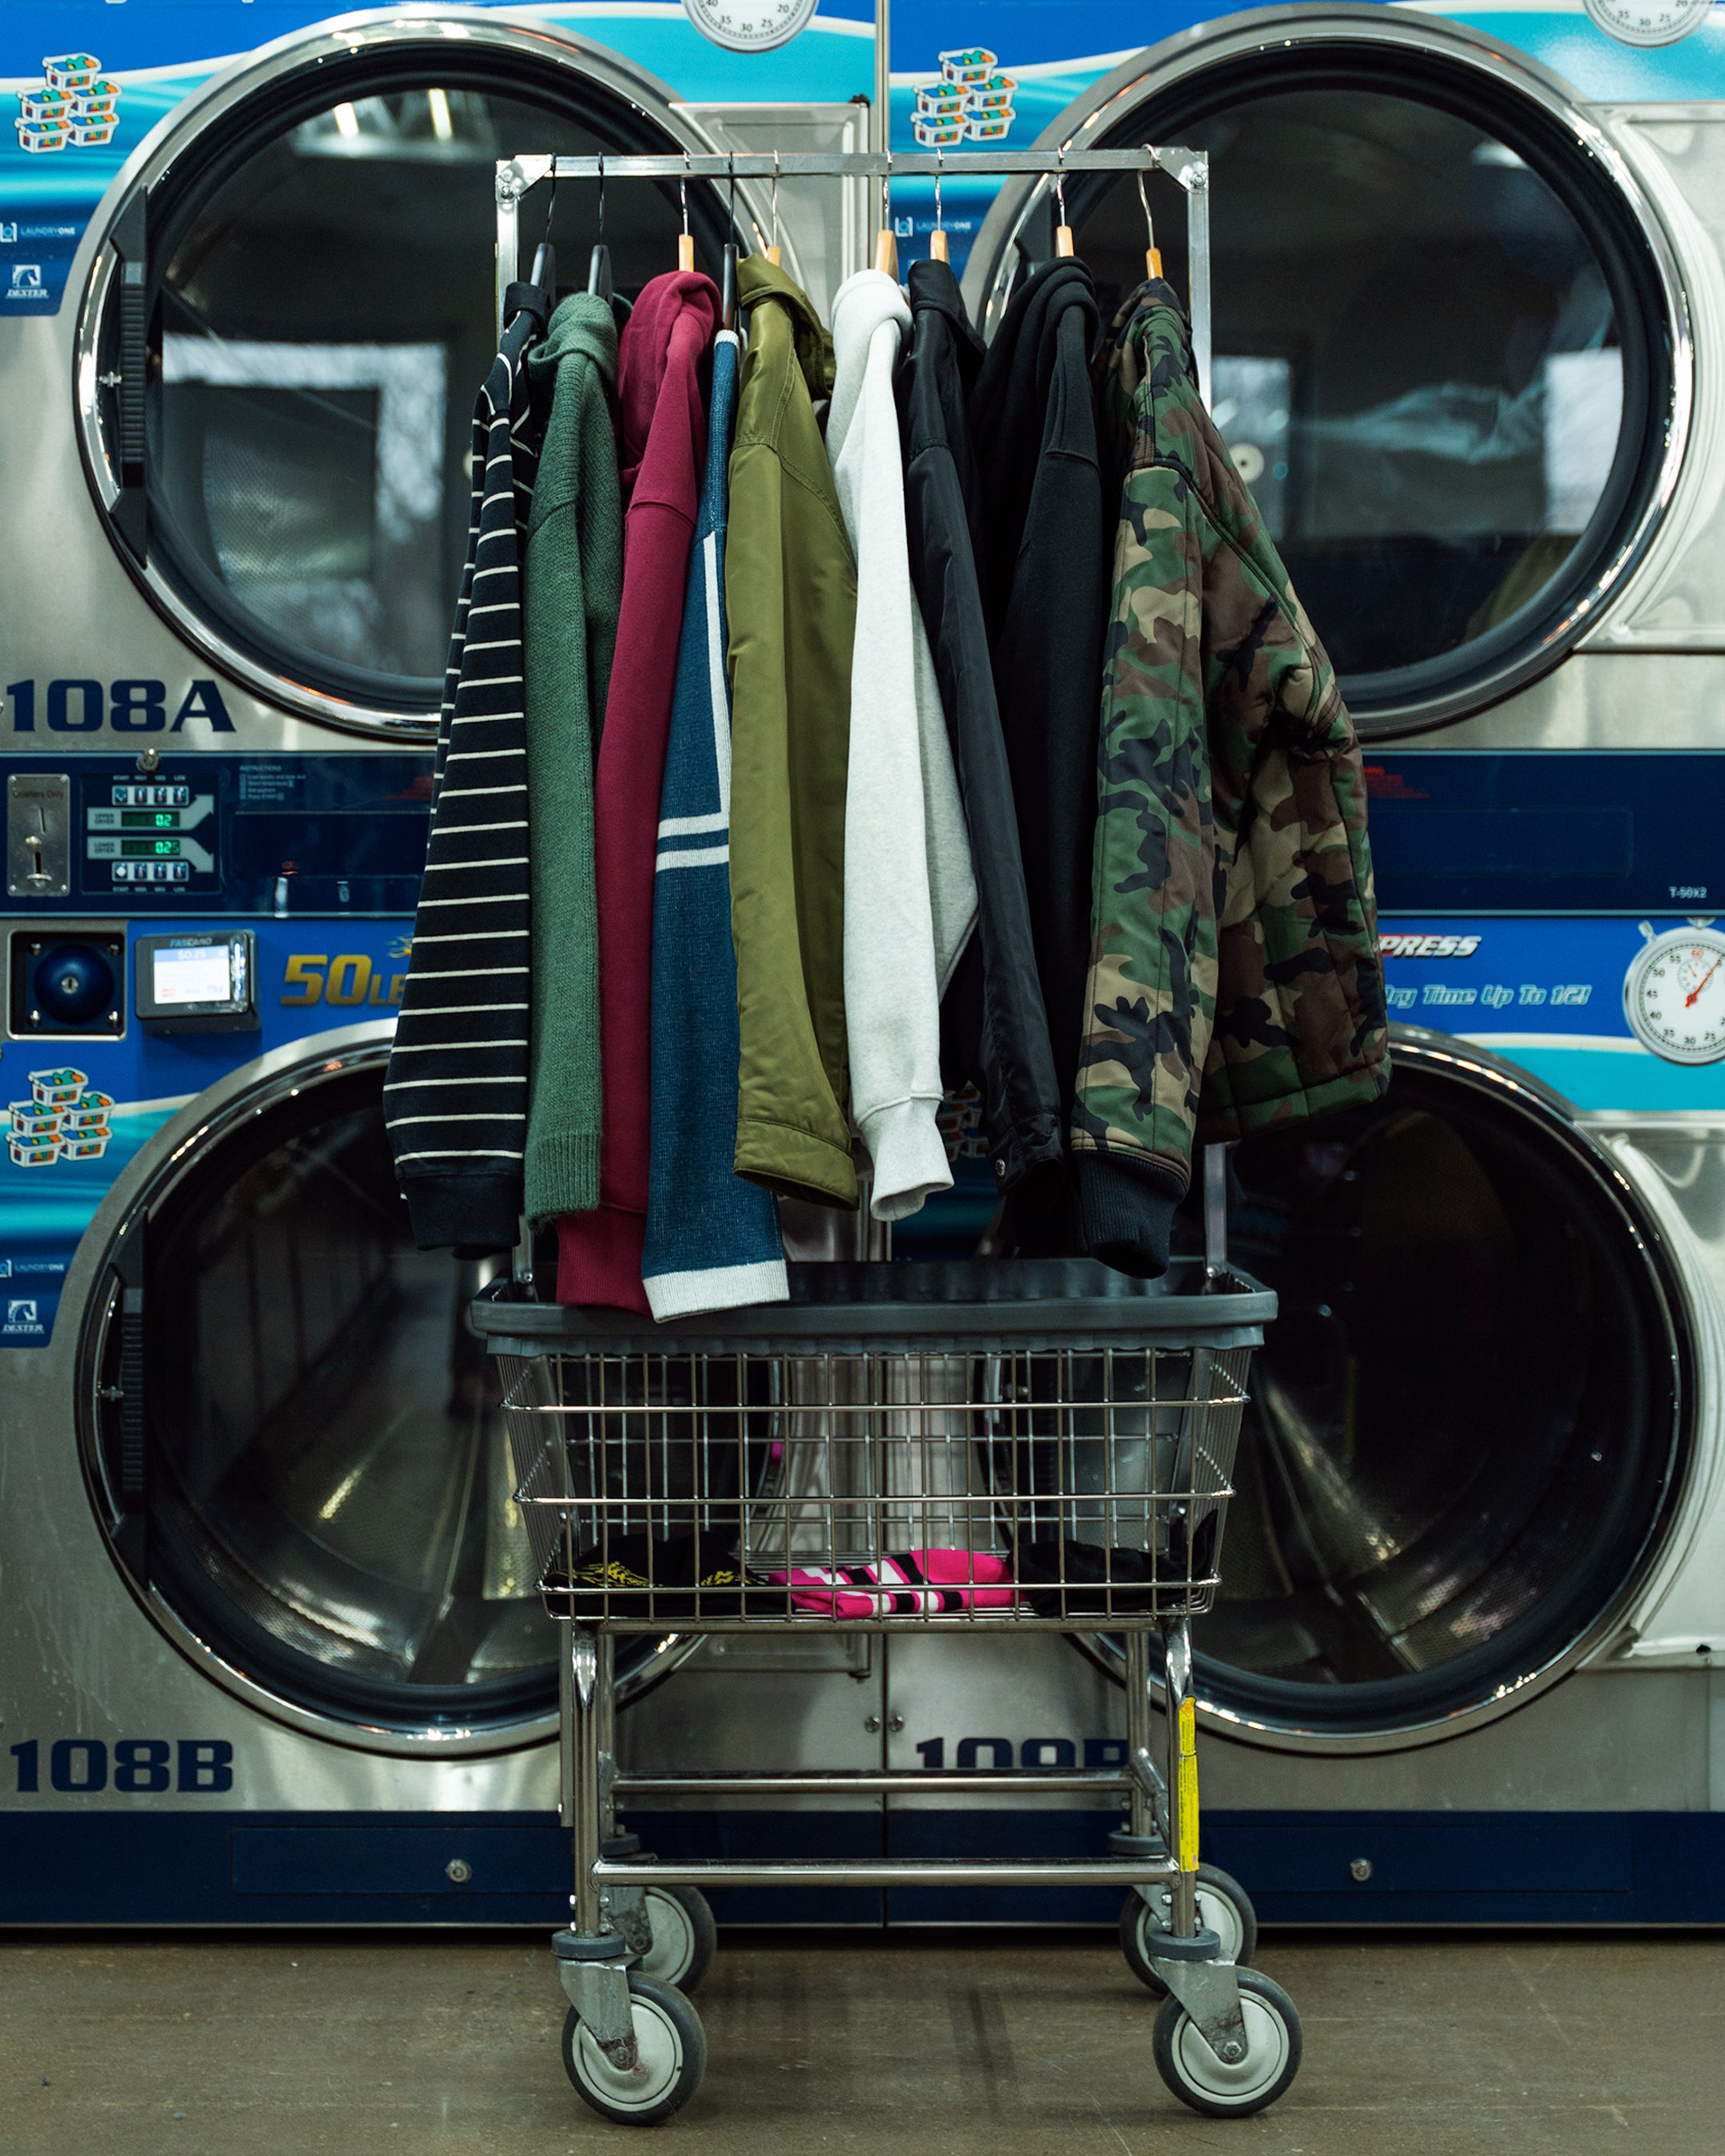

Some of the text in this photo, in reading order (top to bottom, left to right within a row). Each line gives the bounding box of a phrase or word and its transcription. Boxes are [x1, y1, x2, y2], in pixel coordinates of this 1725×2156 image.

[777, 4, 790, 13] 20
[720, 15, 732, 25] 35
[761, 18, 773, 28] 25
[741, 23, 752, 32] 30
[6, 680, 236, 732] 108A
[1379, 934, 1482, 957] PRESS
[1691, 949, 1703, 958] 60
[1653, 968, 1665, 977] 50
[1422, 984, 1477, 1005] Time
[1481, 984, 1514, 1009] Up
[1519, 984, 1548, 1005] To
[1684, 1036, 1696, 1044] 30
[10, 1739, 233, 1792] 108B
